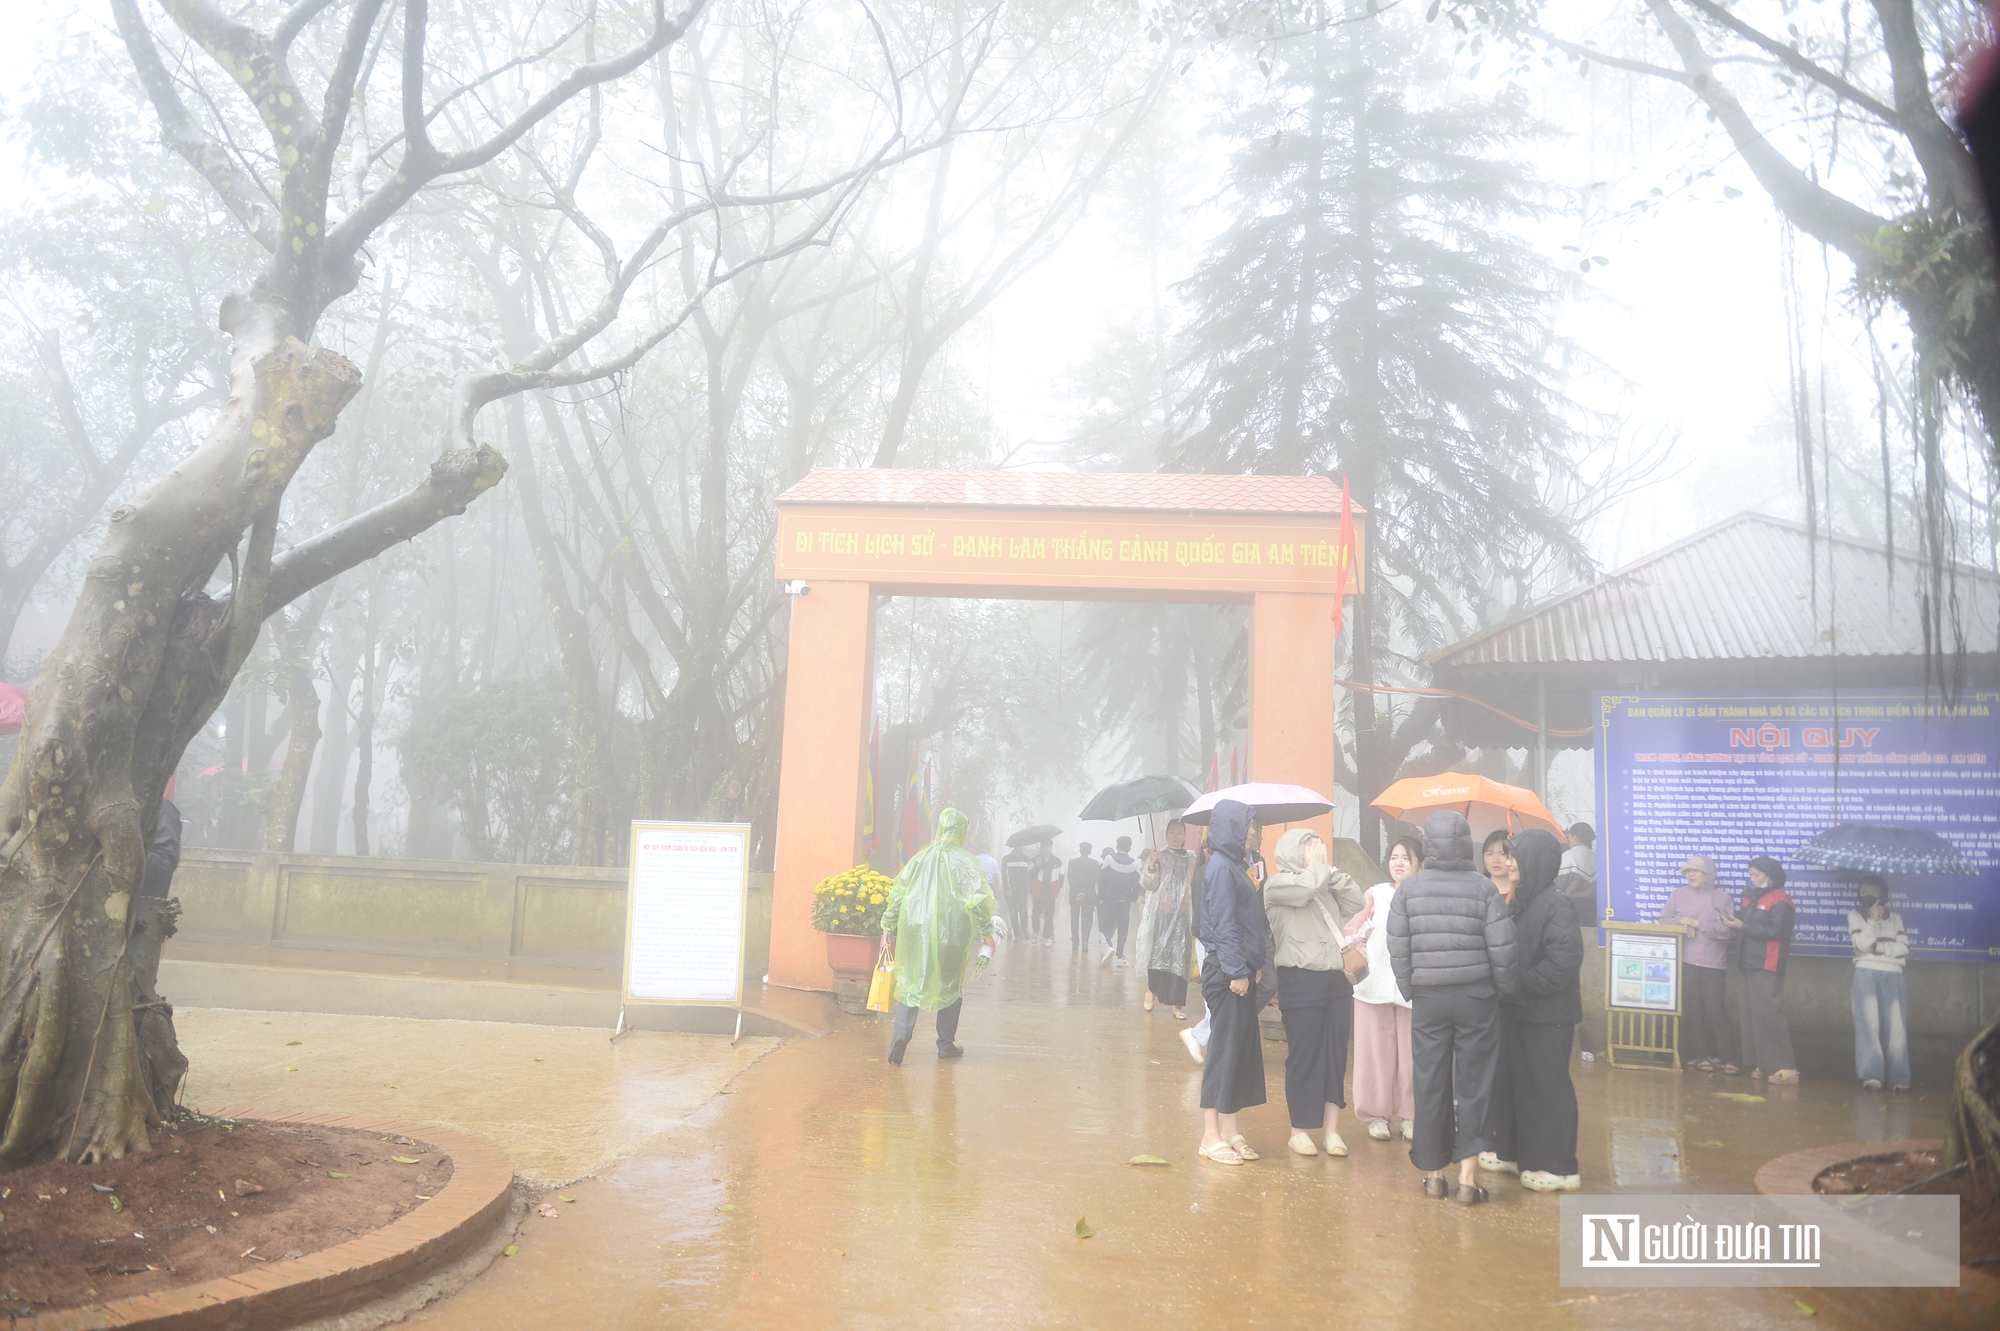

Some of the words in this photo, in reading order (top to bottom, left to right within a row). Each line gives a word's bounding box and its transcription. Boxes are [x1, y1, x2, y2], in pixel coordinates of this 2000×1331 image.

[795, 531, 814, 553] DI
[819, 527, 860, 555] TÍCH
[865, 532, 906, 559] LỊCH
[911, 528, 936, 556] SỬ
[952, 535, 1003, 559] DANH
[1009, 537, 1046, 559] LAM
[1052, 531, 1113, 561] THẮNG
[1119, 534, 1169, 562] CẢNH
[1175, 534, 1226, 566] QUỐC
[1232, 542, 1262, 564] GIA
[1267, 543, 1295, 565] AM
[1300, 539, 1340, 566] TIÊN
[1628, 708, 1646, 717] BAN
[1648, 705, 1672, 718] QUẢN
[1674, 706, 1684, 717] LÝ
[1686, 708, 1695, 717] DI
[1697, 705, 1716, 717] SẢN
[1718, 705, 1747, 717] THÀNH
[1749, 705, 1768, 717] NHÀ
[1784, 705, 1797, 717] VÀ
[1799, 705, 1817, 717] CÁC
[1819, 707, 1829, 717] DI
[1854, 706, 1884, 718] TRỌNG
[1886, 703, 1910, 717] ĐIỂM
[1970, 704, 1989, 717] HÓA
[1730, 722, 1790, 752] NỘI
[1802, 727, 1880, 748] QUY
[1634, 754, 1657, 762] THAM
[1747, 754, 1756, 762] DI
[1757, 752, 1776, 762] TÍCH
[1777, 753, 1795, 764] LỊCH
[1933, 754, 1949, 764] GIA
[1951, 754, 1966, 764] AM
[1967, 753, 1987, 764] TIÊN
